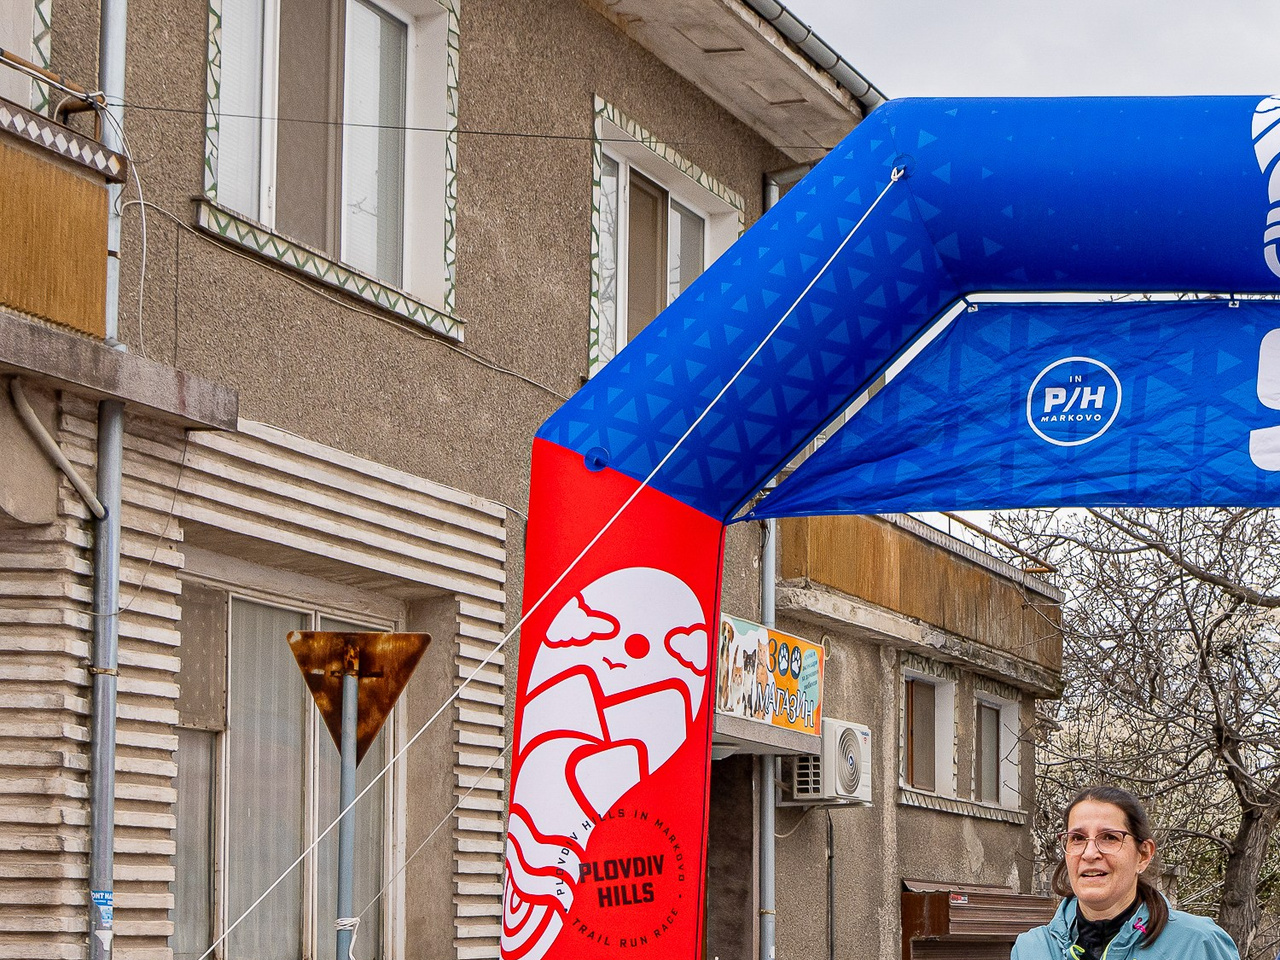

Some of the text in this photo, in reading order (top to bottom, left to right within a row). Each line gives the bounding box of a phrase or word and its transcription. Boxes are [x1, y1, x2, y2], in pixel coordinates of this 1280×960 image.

[1069, 374, 1082, 383] IN
[1043, 385, 1106, 413] P/H
[1040, 413, 1102, 422] MARKOVO
[756, 682, 814, 728] МАГАЗИН
[555, 808, 685, 896] PLOVDIV HILLS IN MARKOVO
[578, 854, 665, 883] PLOVDIV
[597, 882, 655, 908] HILLS
[571, 908, 679, 948] TRAIL RUN RACE
